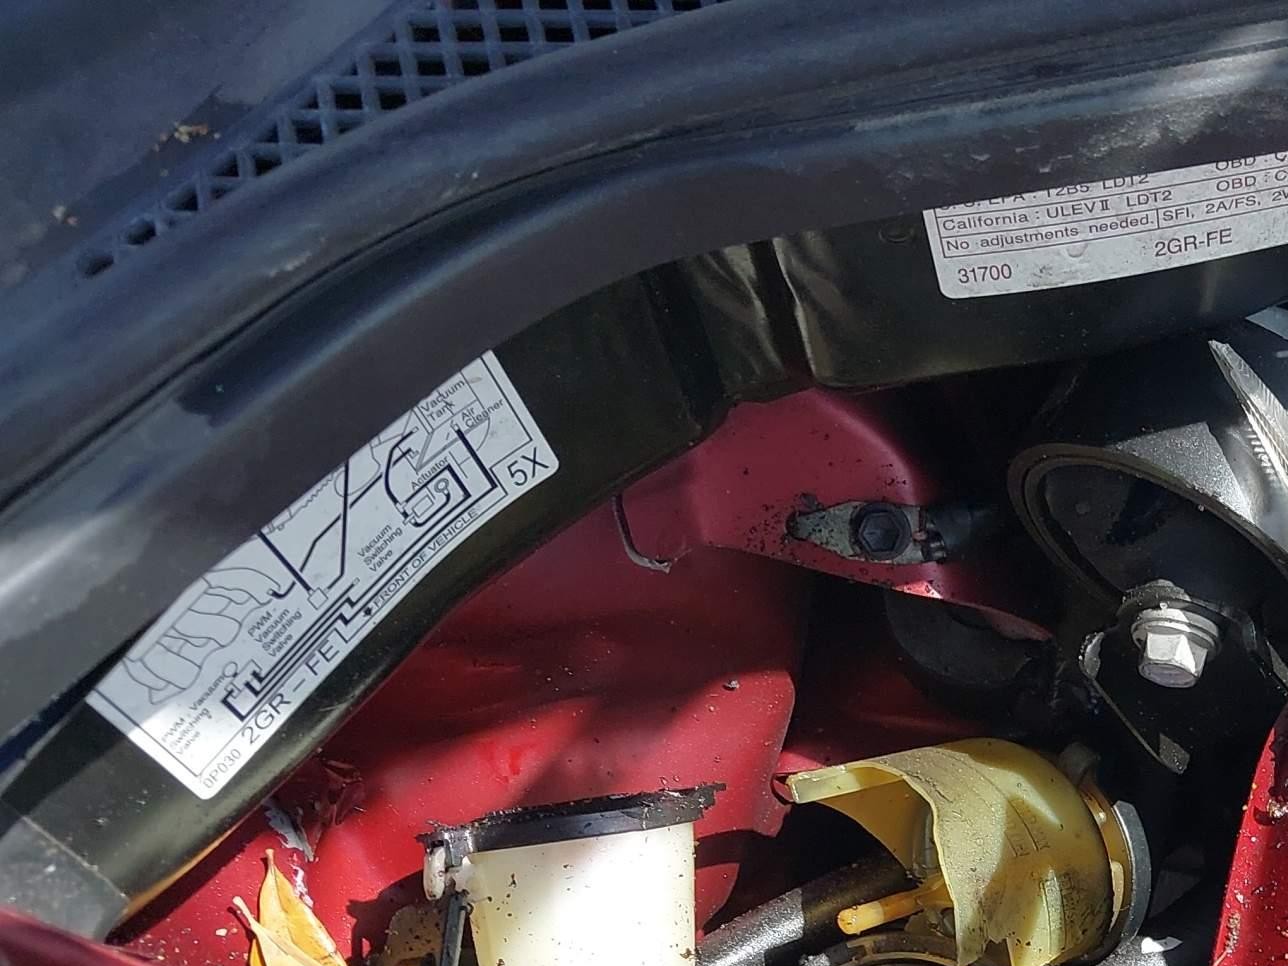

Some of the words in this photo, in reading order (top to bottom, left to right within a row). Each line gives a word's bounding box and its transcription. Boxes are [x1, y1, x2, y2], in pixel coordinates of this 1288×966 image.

[1216, 175, 1257, 192] OBD
[942, 211, 1029, 232] California
[1126, 190, 1173, 207] LDT2
[1162, 207, 1195, 222] SFI,
[1205, 194, 1262, 214] 2A/FS,
[946, 239, 970, 252] No
[980, 227, 1079, 253] adjustments
[1089, 213, 1154, 234] needed.
[1154, 228, 1233, 258] 2GR-FE
[957, 263, 1013, 284] 31700
[421, 380, 465, 412] Vacuum
[461, 407, 475, 421] Air
[465, 399, 504, 428] Cleaner
[411, 455, 450, 491] Actuator
[507, 447, 549, 487] 5X
[357, 525, 392, 557] Vacuum
[363, 527, 403, 566] Switching
[369, 550, 393, 572] Valve
[373, 568, 410, 607] FRONT
[411, 551, 428, 569] OF
[428, 508, 478, 552] VEHICLE
[248, 611, 273, 637] PWM
[254, 609, 290, 642] Vacuum
[262, 610, 302, 651] Switching
[267, 634, 293, 656] Valve
